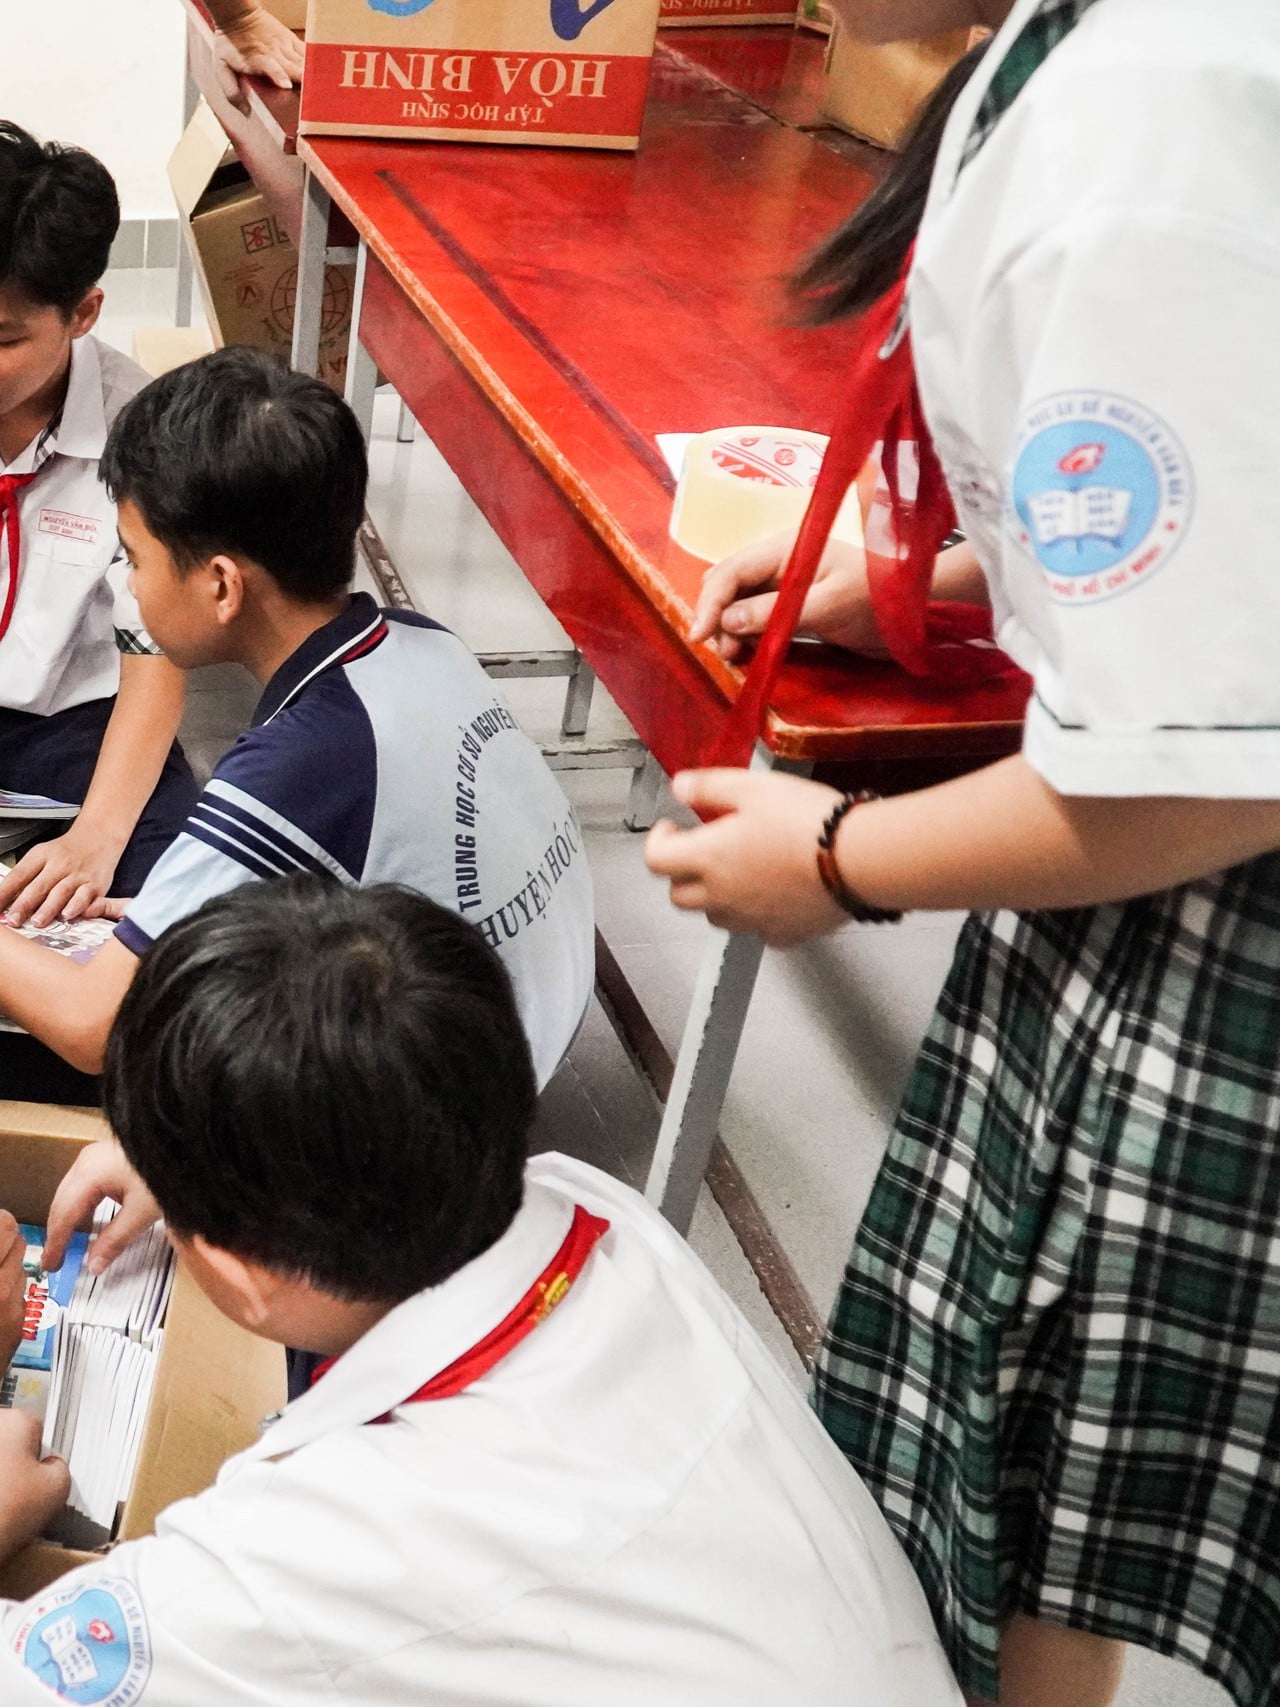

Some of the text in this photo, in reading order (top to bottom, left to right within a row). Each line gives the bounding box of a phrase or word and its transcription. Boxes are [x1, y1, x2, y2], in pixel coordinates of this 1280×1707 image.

[338, 50, 612, 108] HÒA BÌNH
[401, 101, 545, 127] TẬP HỌC SINH
[457, 749, 476, 783] CƠ
[456, 781, 480, 828] HỌC
[455, 833, 482, 913] TRUNG
